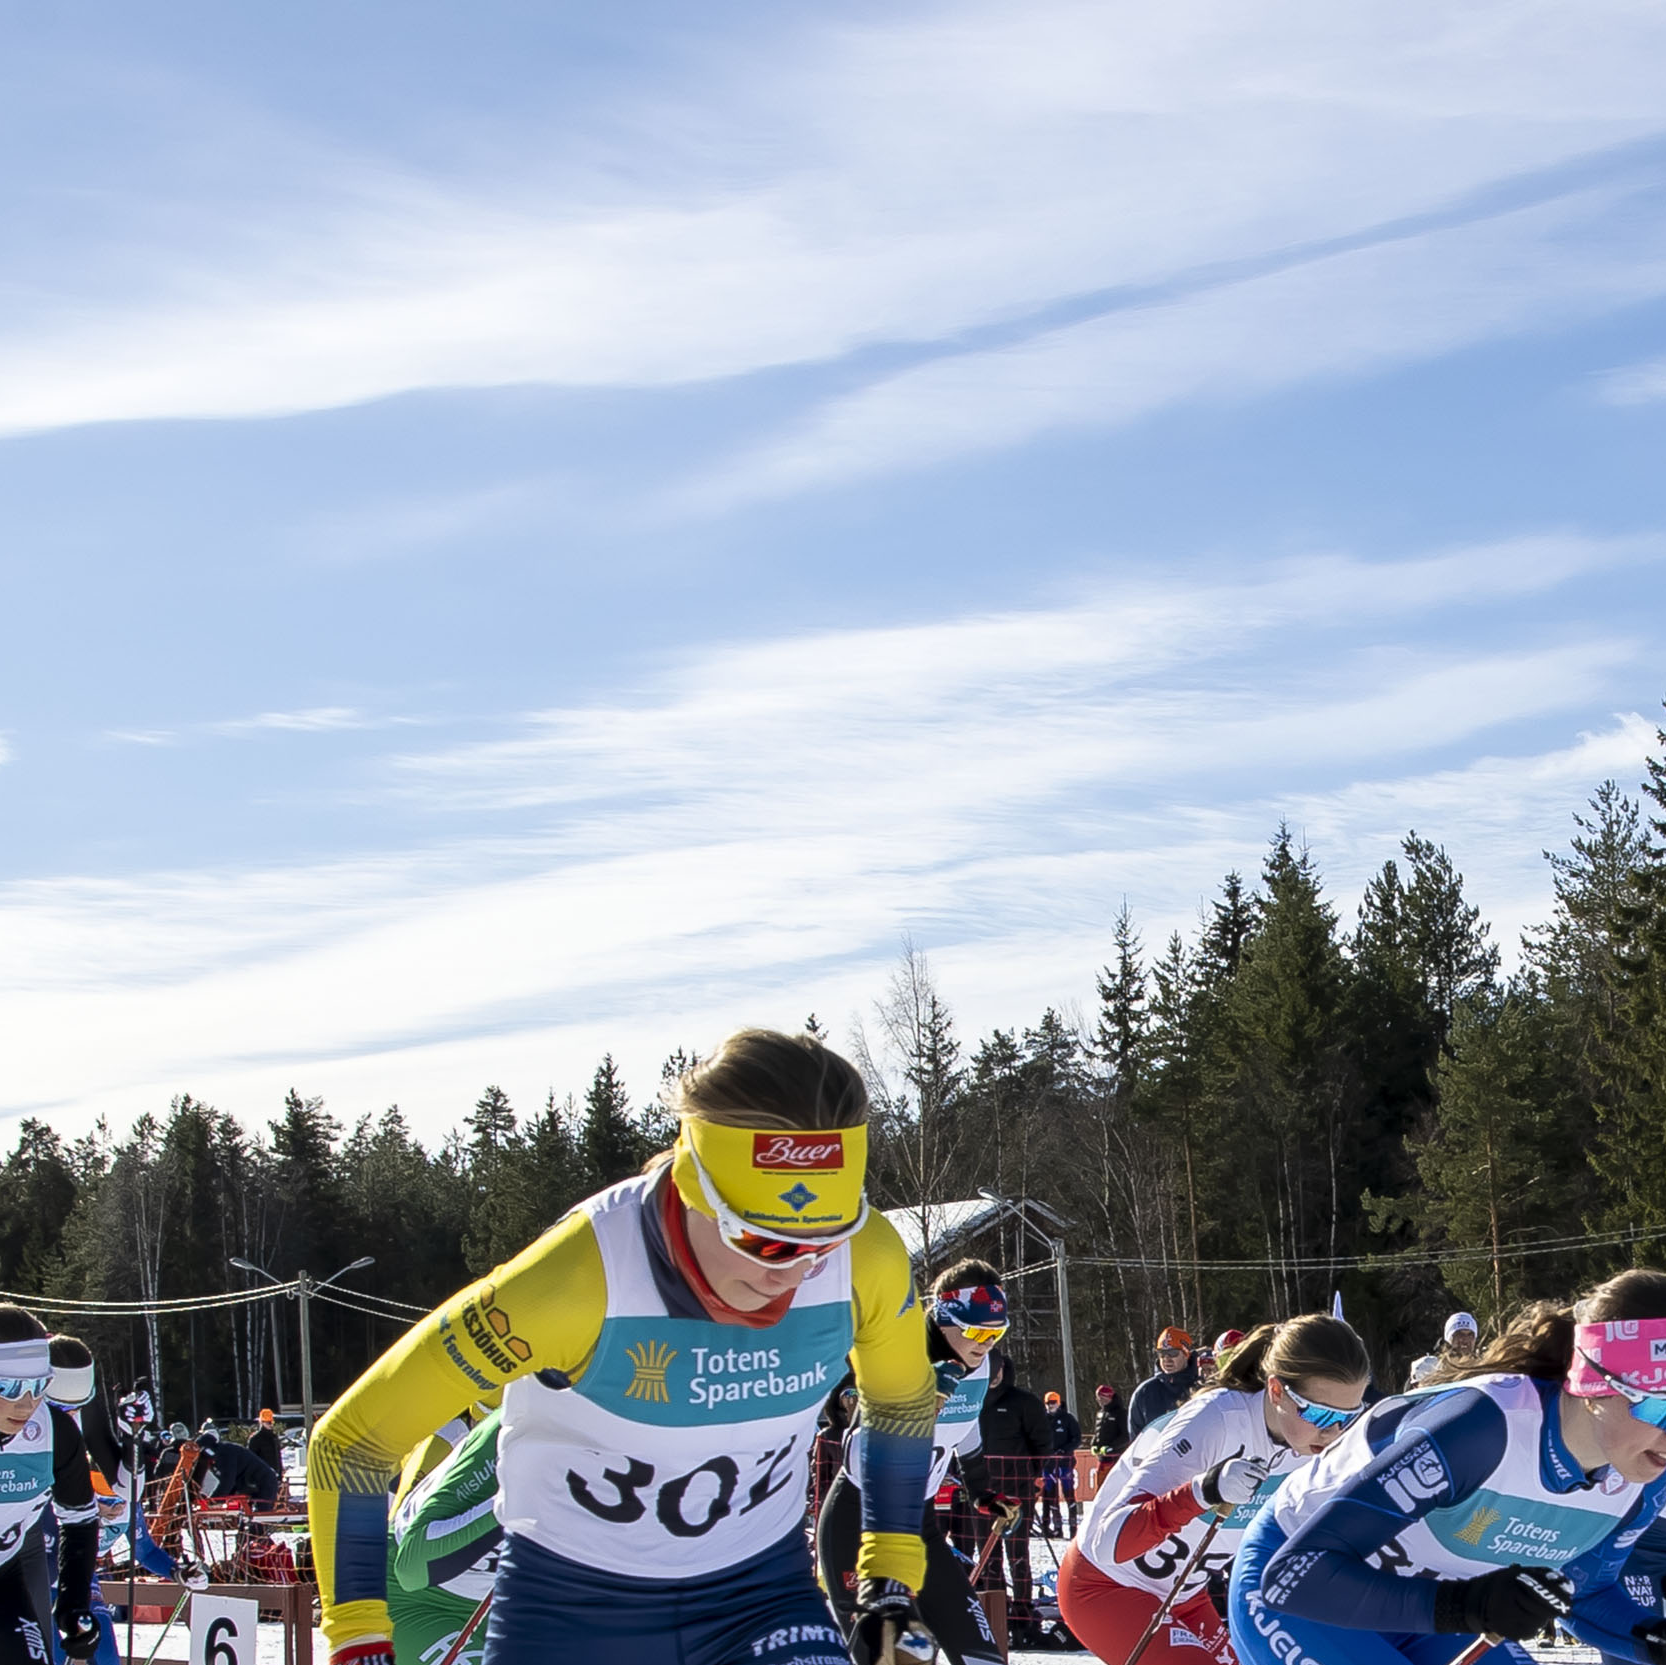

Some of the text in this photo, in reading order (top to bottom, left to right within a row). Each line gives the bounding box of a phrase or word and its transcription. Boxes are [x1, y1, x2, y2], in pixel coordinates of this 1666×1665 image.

[756, 1136, 840, 1166] Buer
[691, 1348, 782, 1377] Totens
[689, 1365, 828, 1409] Sparebank
[567, 1435, 797, 1539] 302
[1502, 1515, 1560, 1543] Totens
[1486, 1534, 1578, 1563] Sparebank
